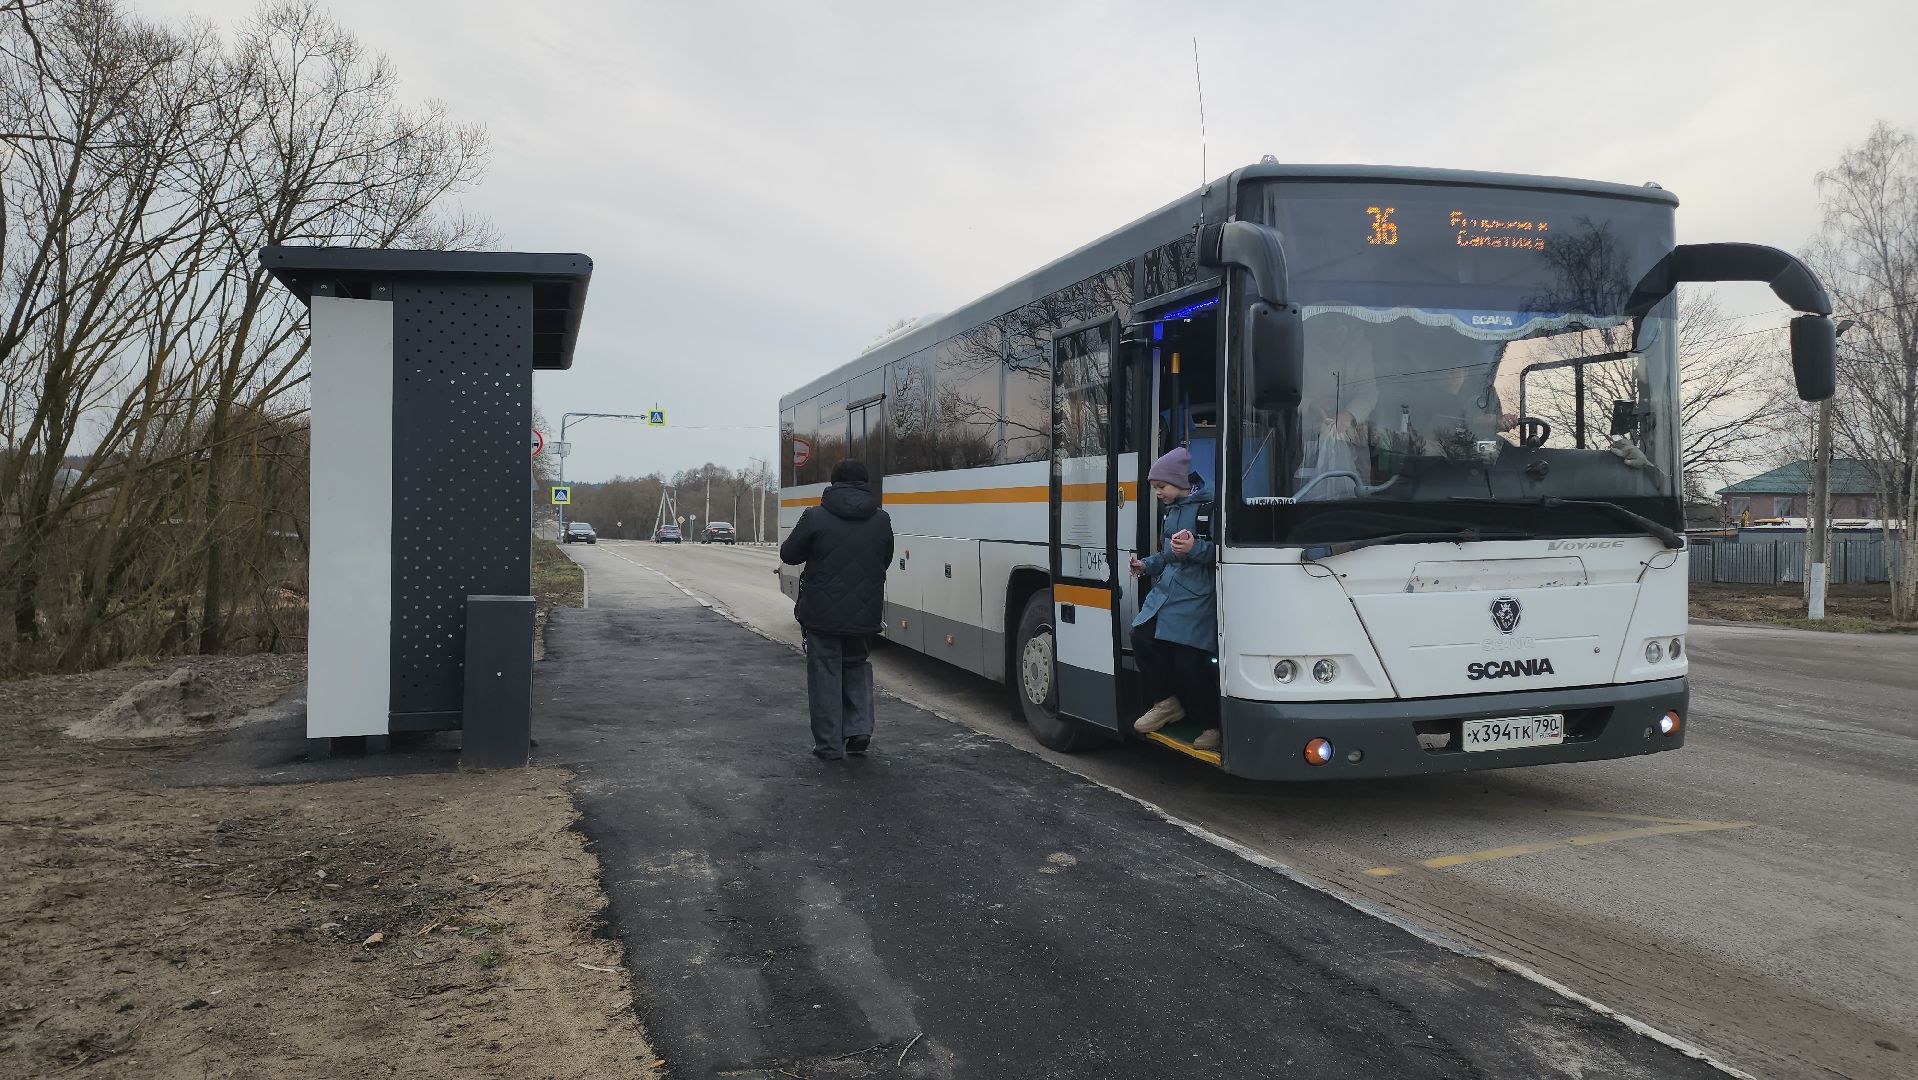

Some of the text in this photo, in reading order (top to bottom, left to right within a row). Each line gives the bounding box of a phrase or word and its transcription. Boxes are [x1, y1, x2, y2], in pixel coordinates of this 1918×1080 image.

[1367, 206, 1398, 246] 36
[1467, 658, 1555, 681] SCANIA
[1534, 718, 1557, 733] 790
